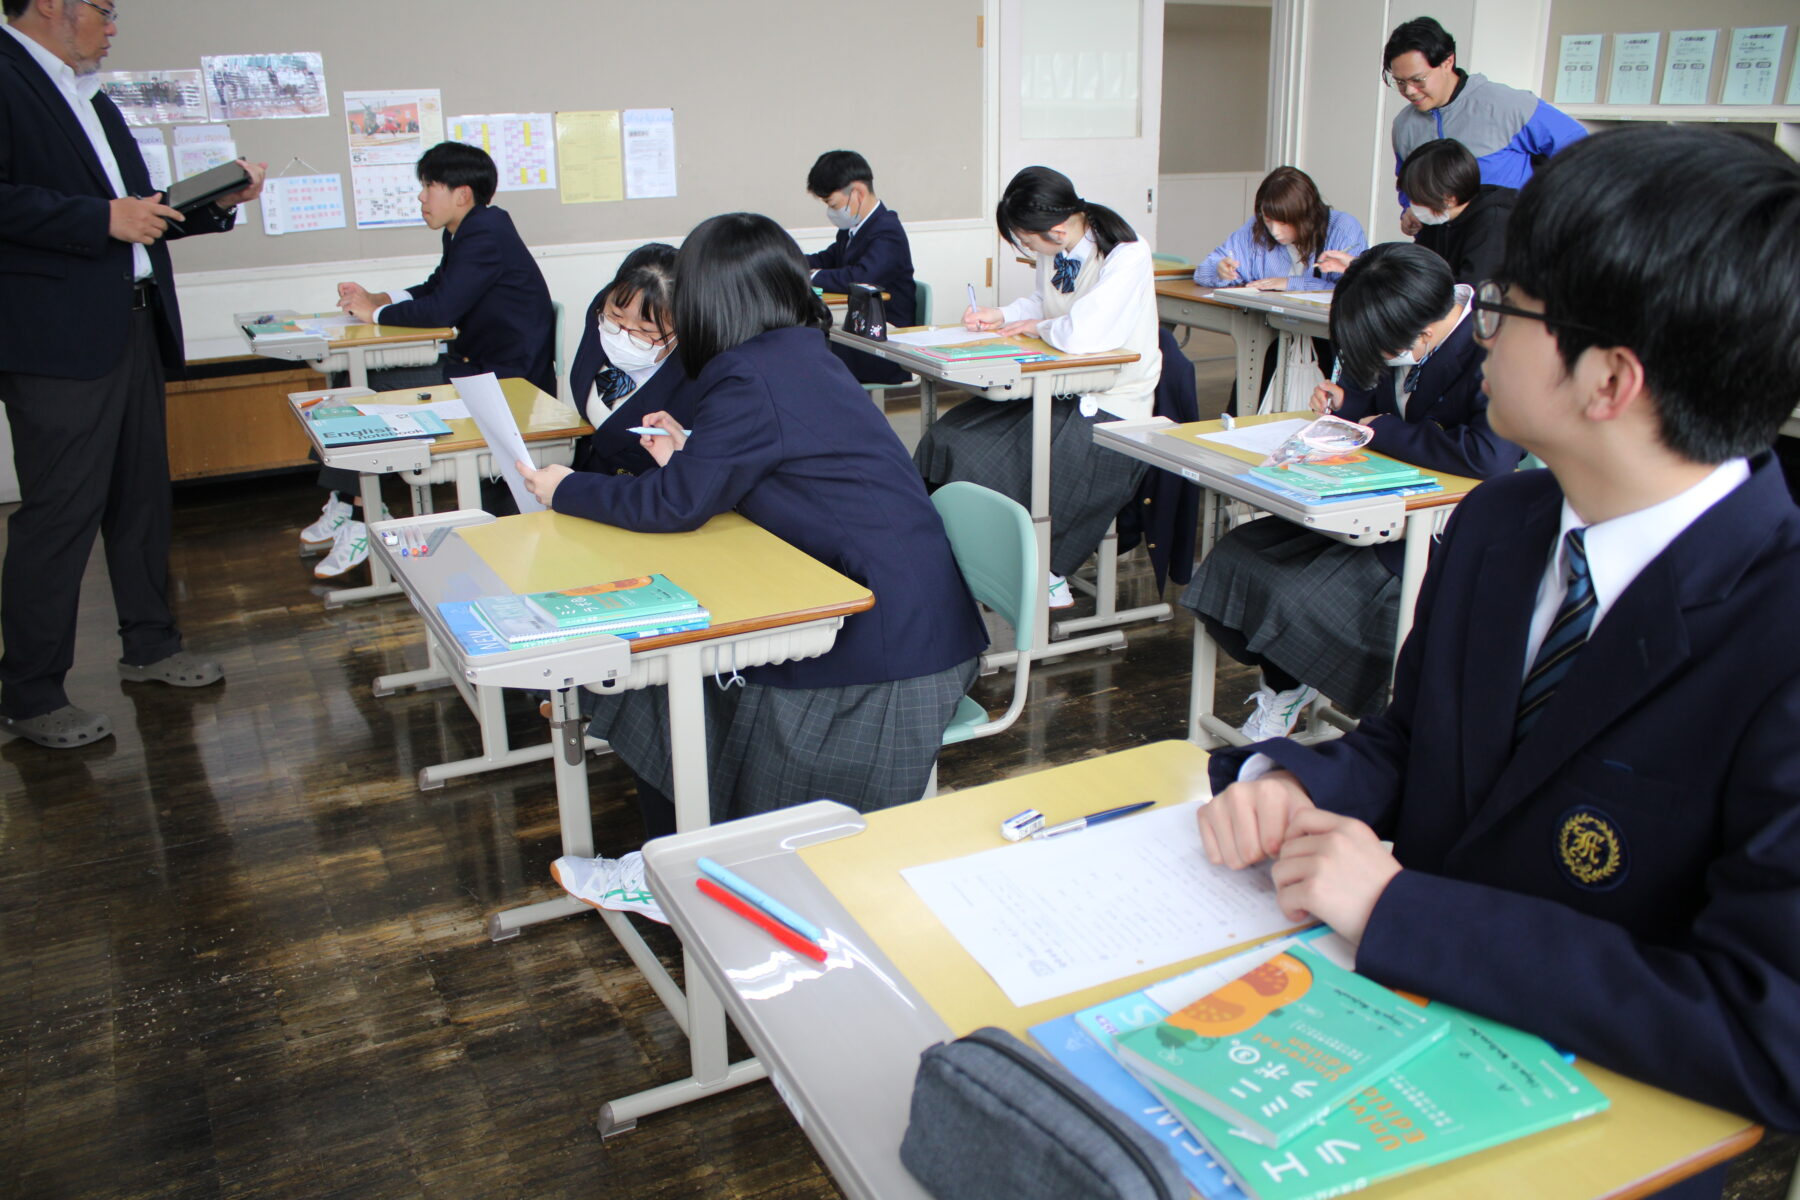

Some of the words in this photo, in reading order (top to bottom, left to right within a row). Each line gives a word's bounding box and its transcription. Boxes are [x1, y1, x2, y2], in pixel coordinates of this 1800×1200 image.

[322, 426, 398, 439] English
[358, 429, 424, 440] notebook
[1252, 1032, 1339, 1082] Universal
[1288, 1037, 1352, 1075] Edition
[1229, 1078, 1289, 1118] ミニ
